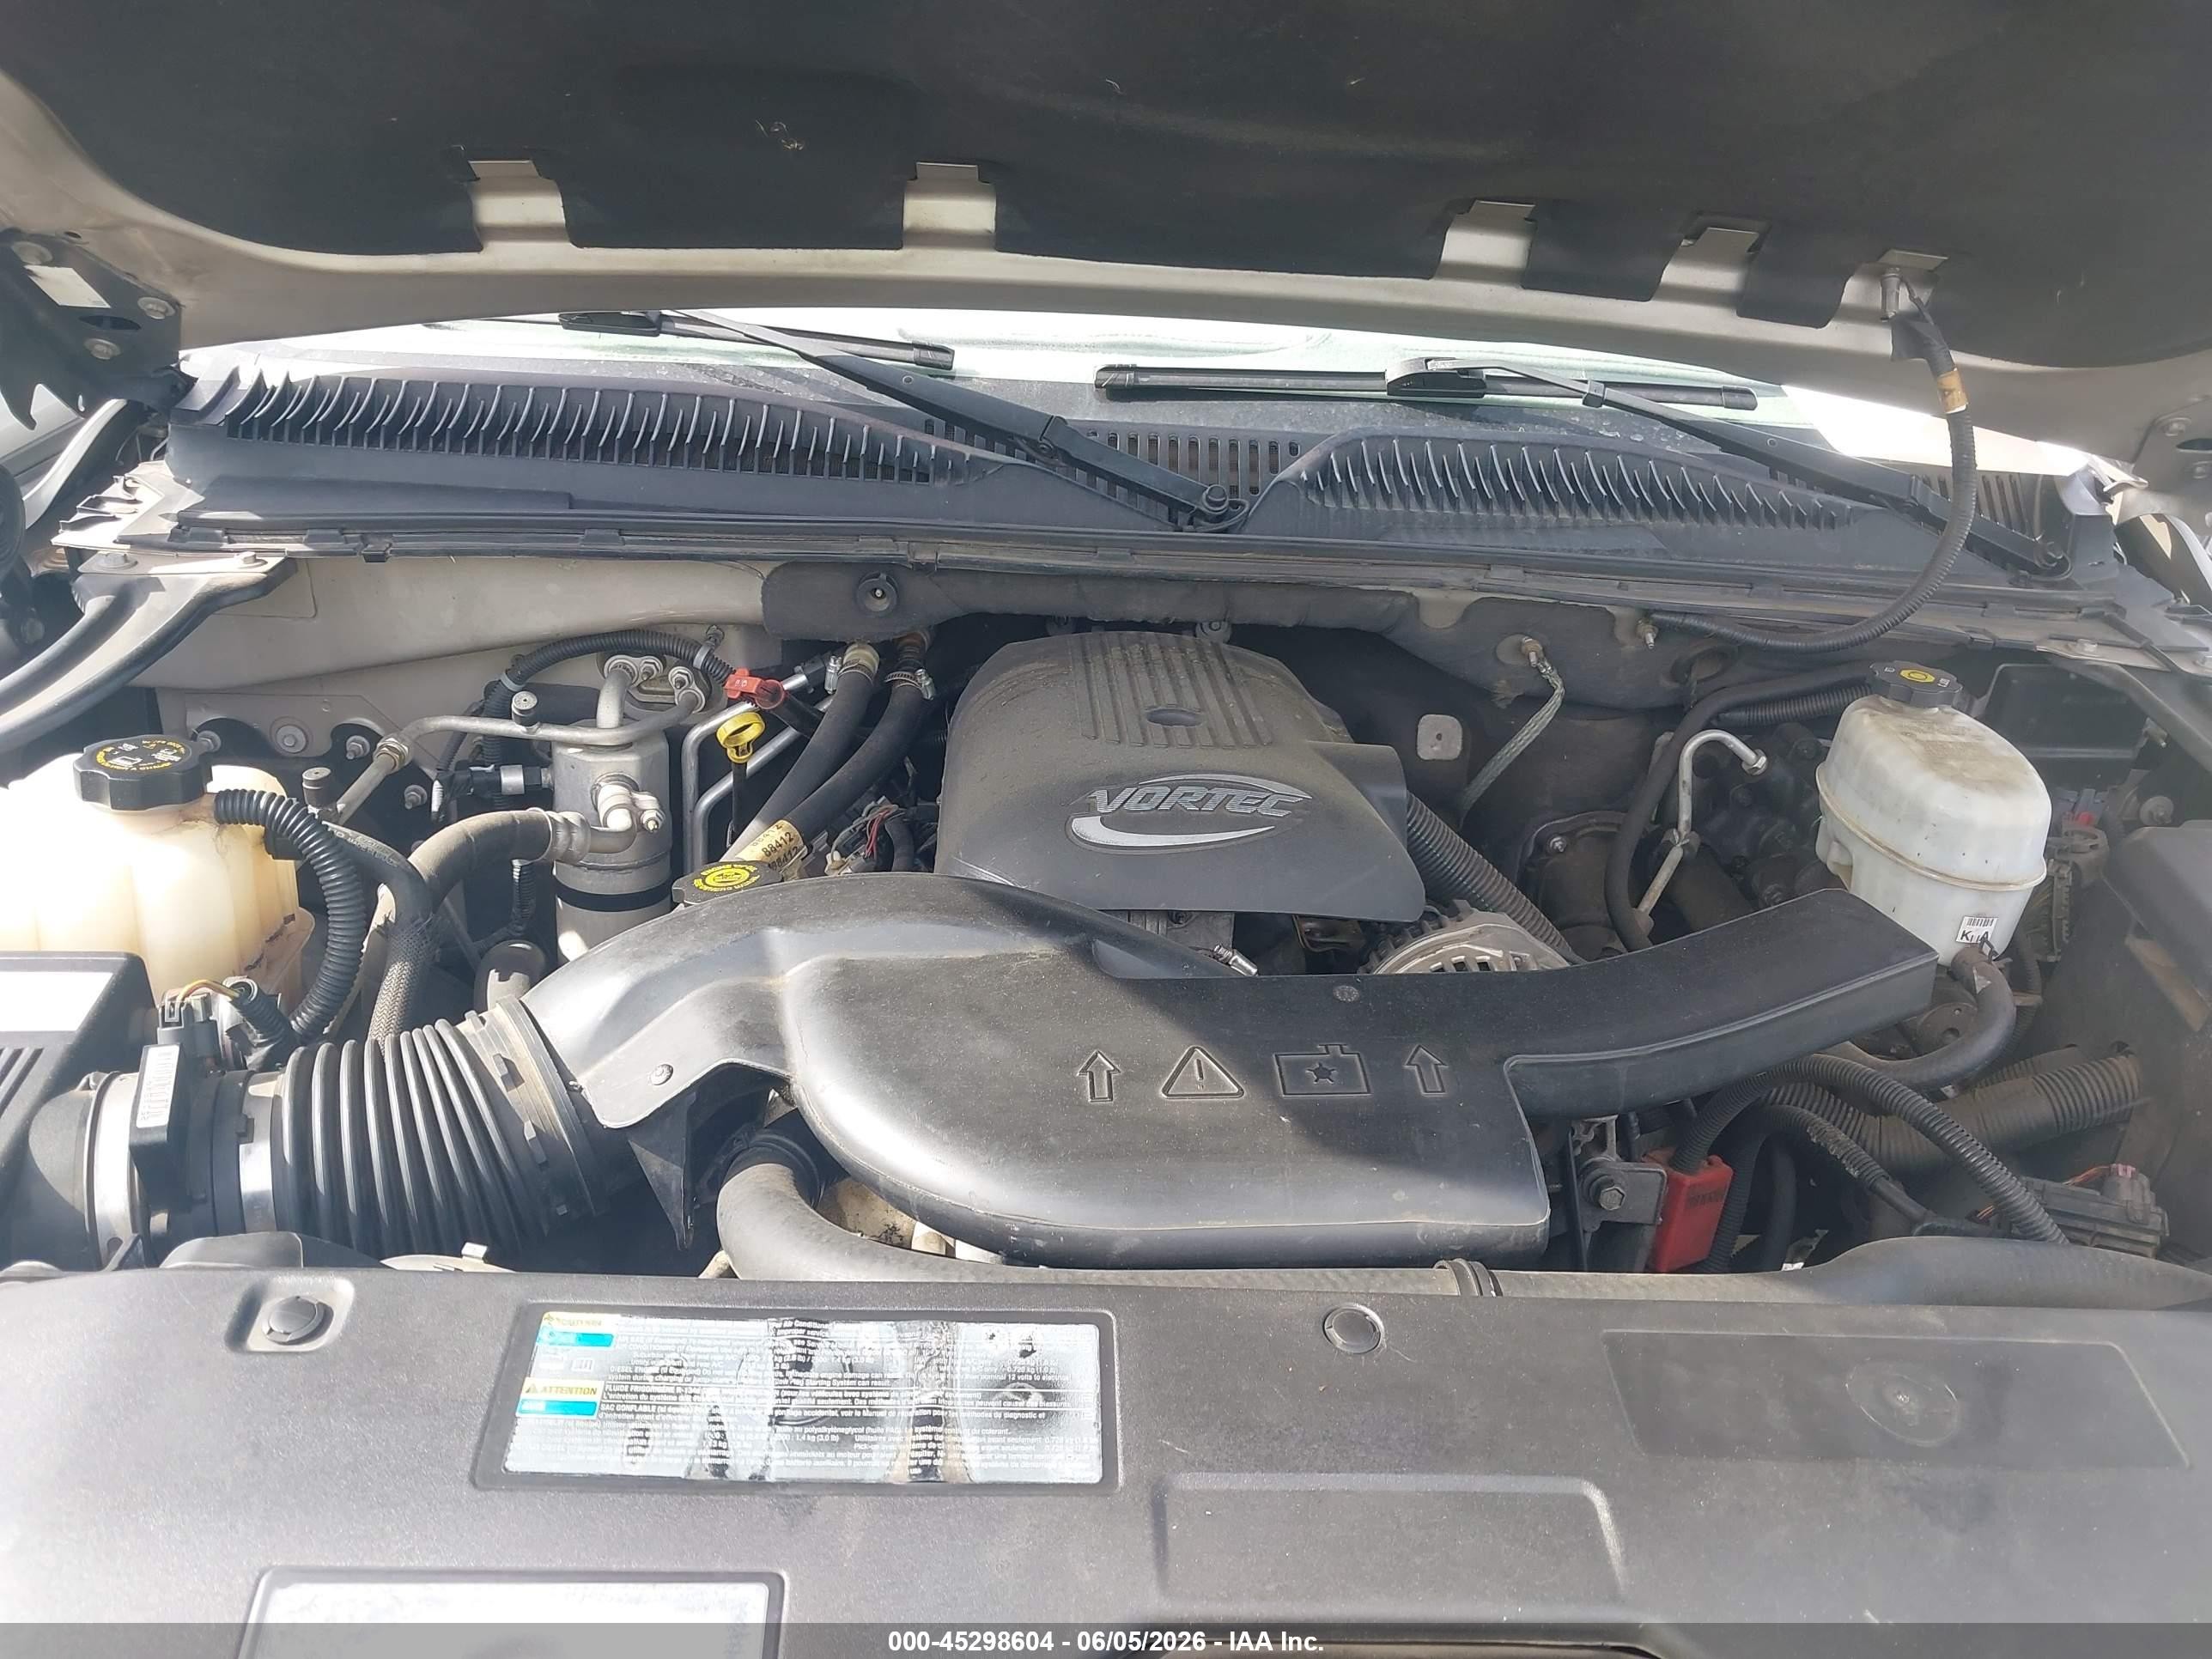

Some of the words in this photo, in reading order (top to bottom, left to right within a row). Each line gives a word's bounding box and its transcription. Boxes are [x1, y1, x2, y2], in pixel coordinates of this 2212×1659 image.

[1089, 786, 1304, 817] VORTEC
[761, 831, 794, 858] 88412
[654, 1374, 684, 1383] charging
[843, 1371, 870, 1380] damage
[832, 1379, 857, 1388] System
[540, 1386, 598, 1395] ATTENTION
[605, 1384, 629, 1393] FLUIDE
[649, 1394, 678, 1402] système
[601, 1402, 616, 1411] SAC
[1003, 1411, 1037, 1420] diagnostic
[830, 1435, 840, 1443] lb)
